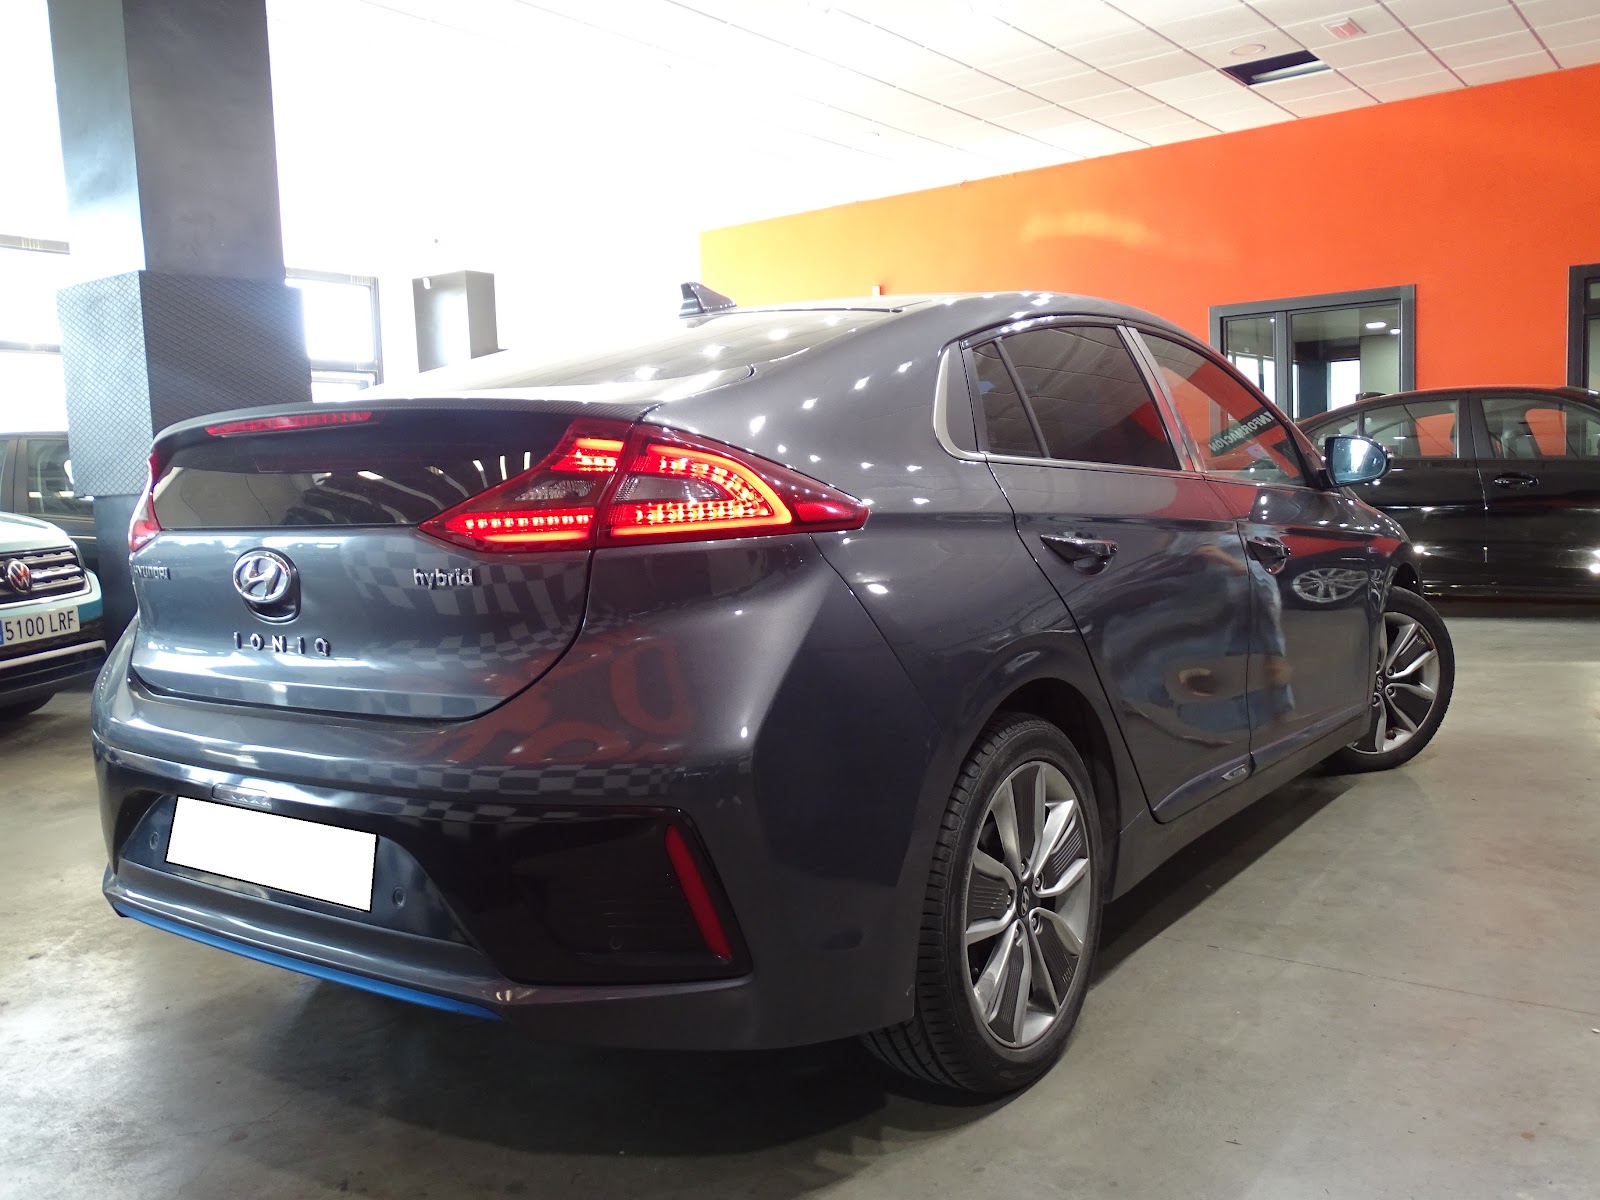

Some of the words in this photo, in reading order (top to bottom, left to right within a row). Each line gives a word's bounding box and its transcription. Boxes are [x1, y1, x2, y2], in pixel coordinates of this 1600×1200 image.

[412, 567, 474, 590] hybrid
[4, 616, 45, 641] 5100
[49, 610, 75, 633] LRF
[233, 631, 331, 657] IONIQ
